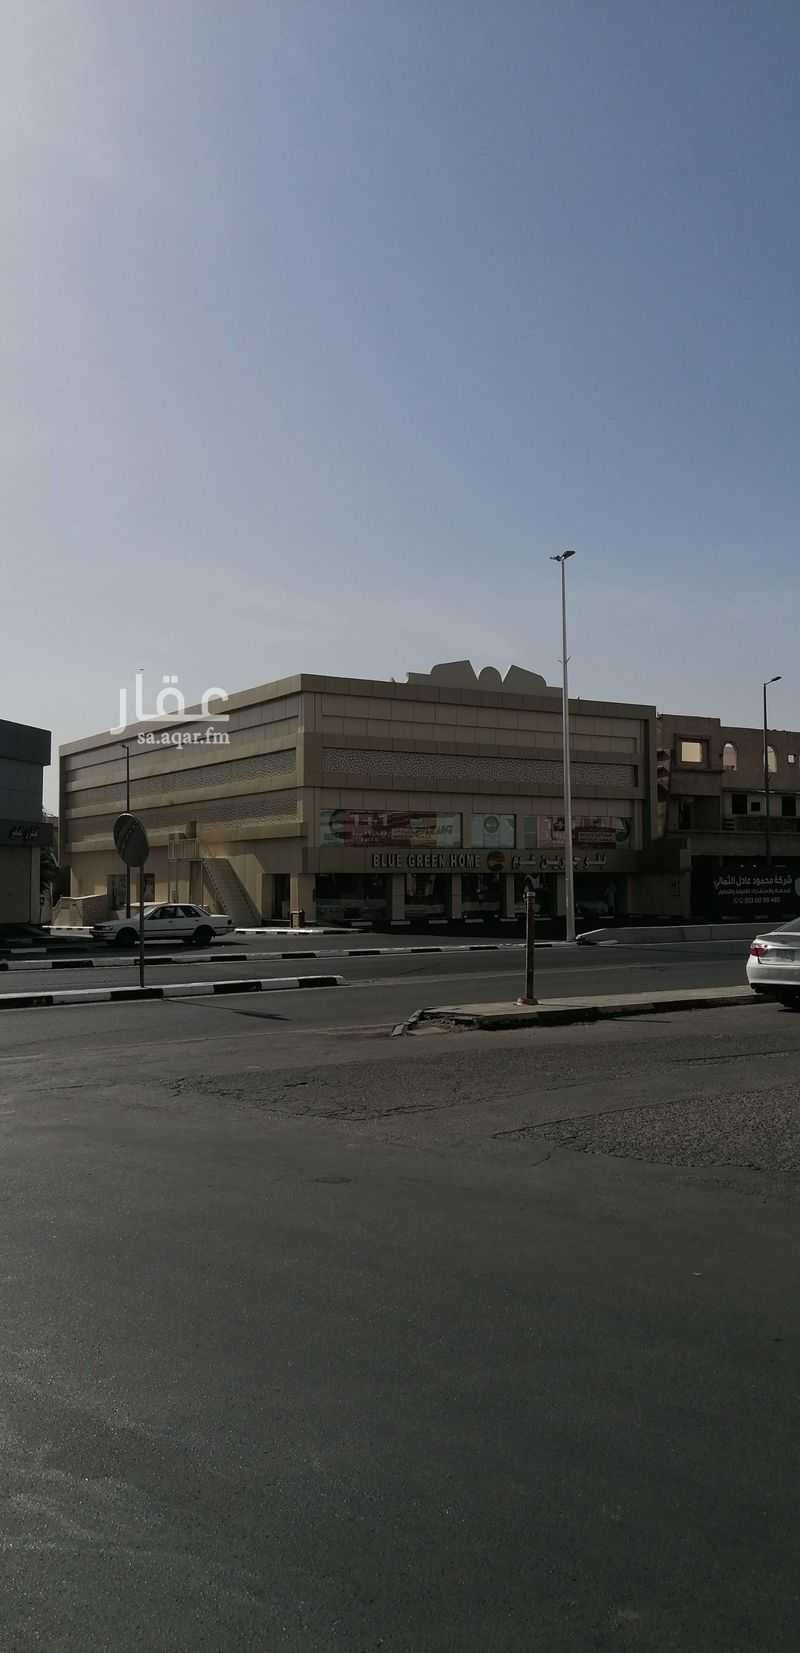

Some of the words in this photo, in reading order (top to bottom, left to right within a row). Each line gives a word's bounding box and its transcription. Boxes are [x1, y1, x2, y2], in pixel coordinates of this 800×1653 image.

[372, 854, 401, 868] BLUE
[408, 854, 447, 868] GREEN
[450, 854, 481, 868] HOME
